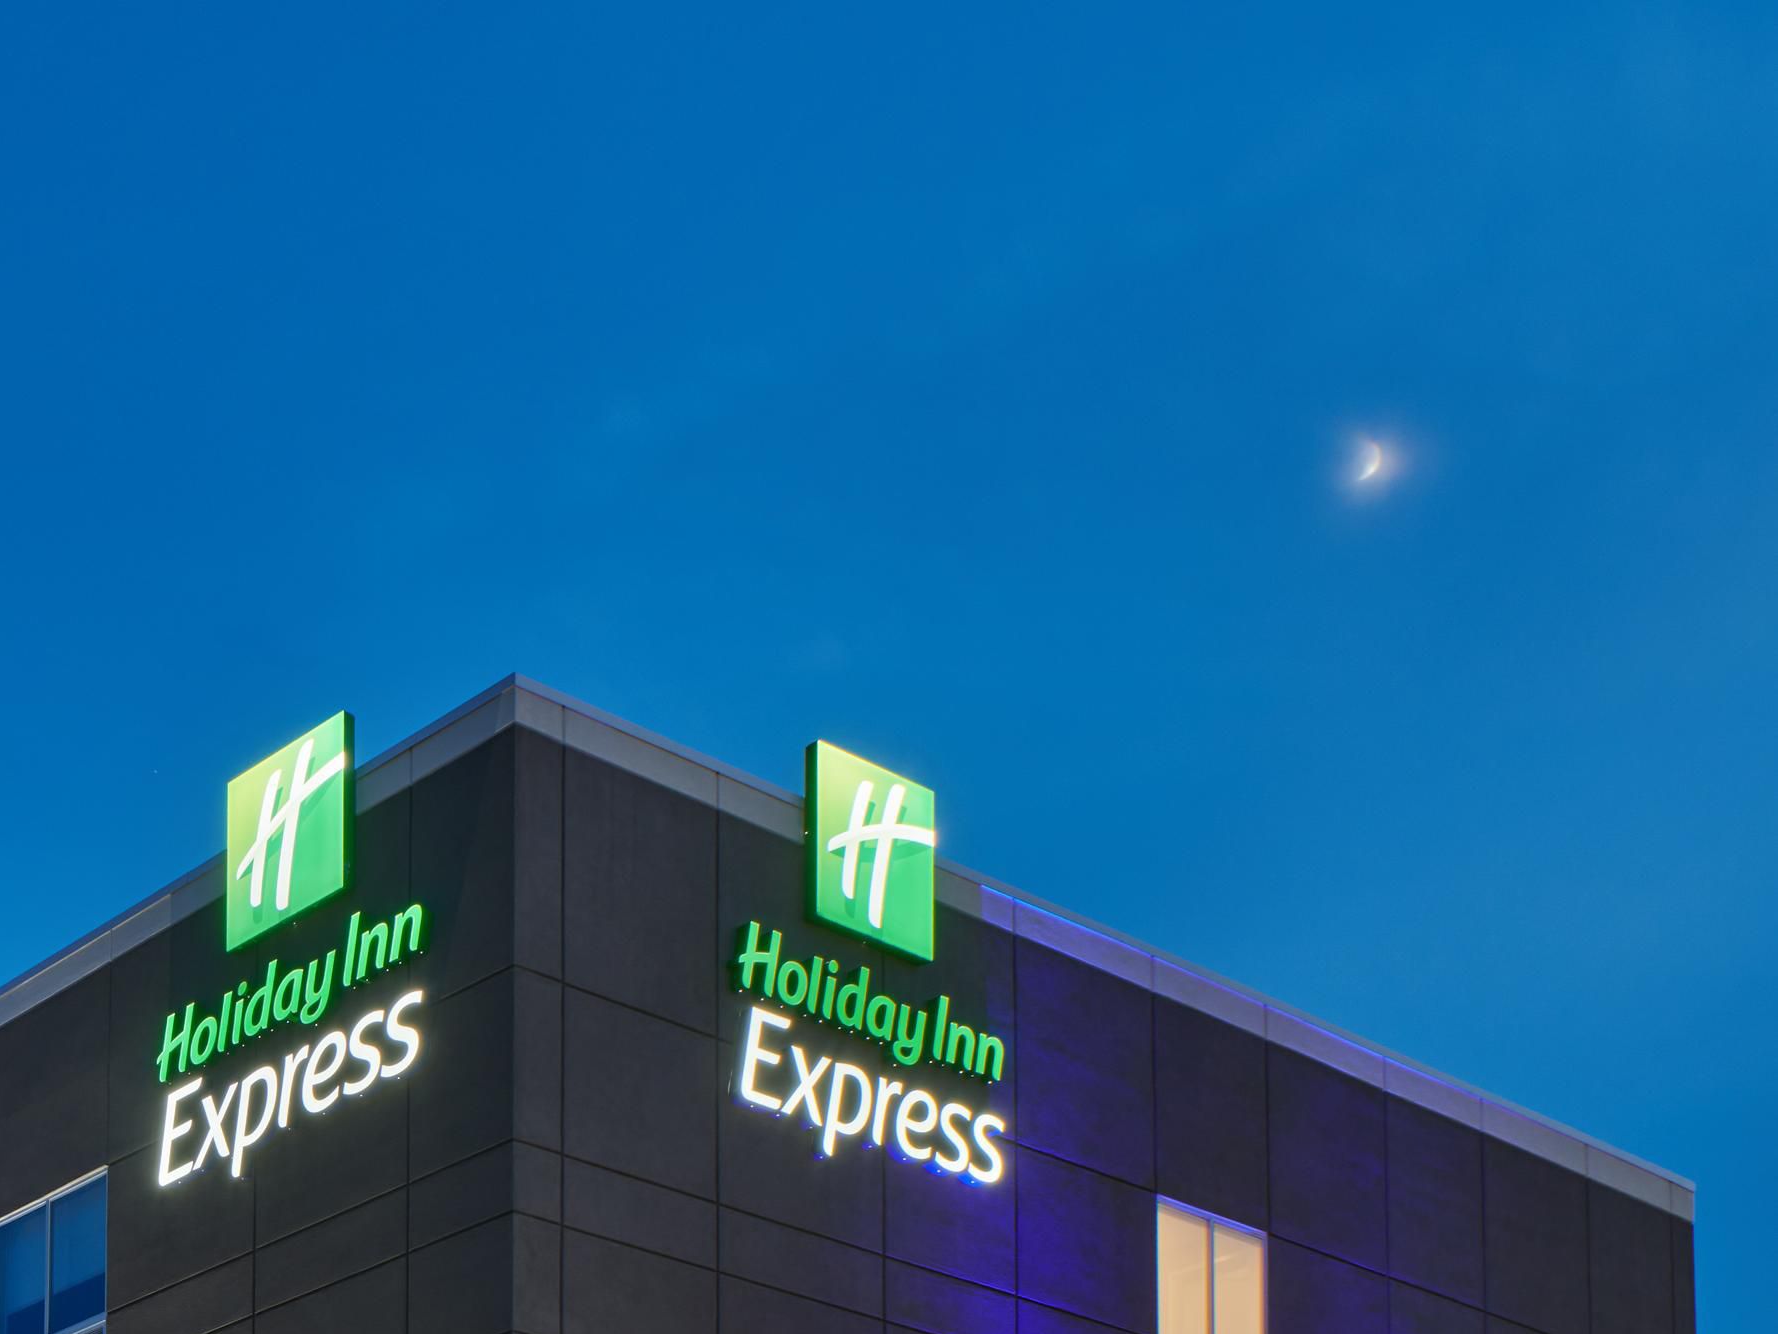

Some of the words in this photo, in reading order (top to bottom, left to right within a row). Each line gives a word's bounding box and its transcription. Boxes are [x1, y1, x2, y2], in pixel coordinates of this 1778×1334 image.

[156, 949, 336, 1083] Holiday
[342, 903, 424, 988] Inn
[737, 920, 927, 1067] Holiday
[932, 994, 1005, 1082] Inn
[158, 990, 424, 1187] Express
[740, 1005, 1006, 1184] Express
